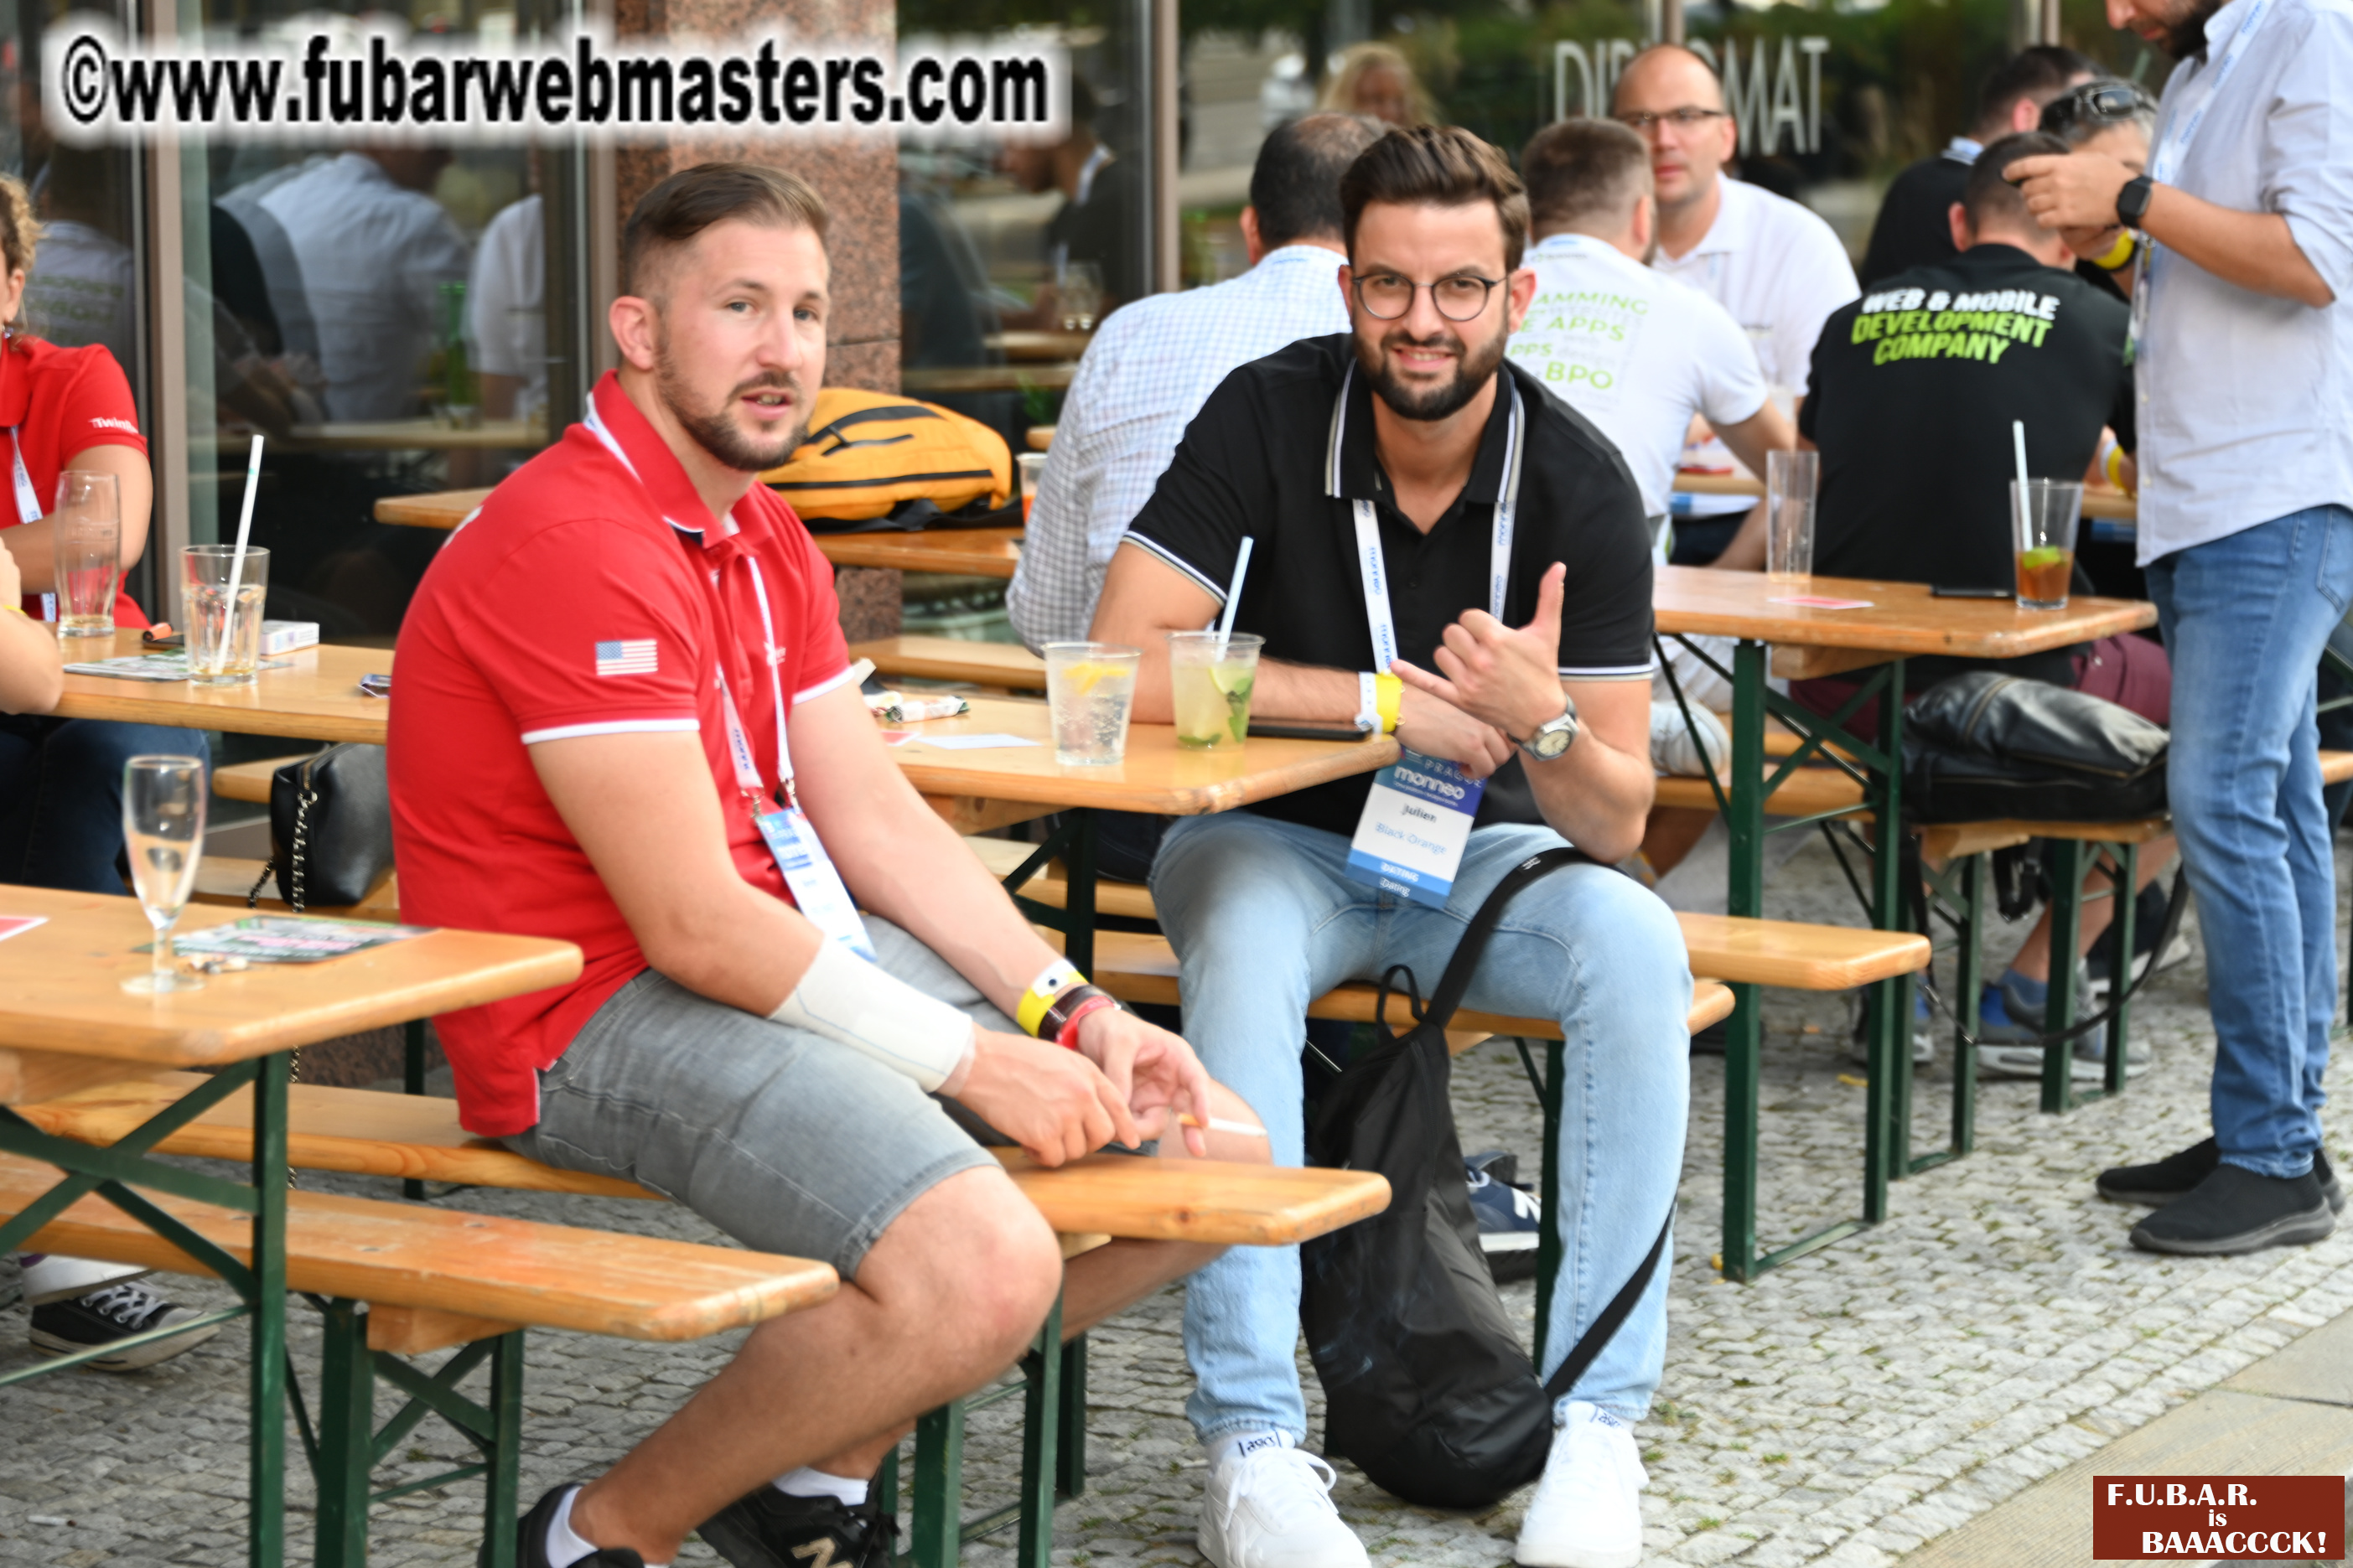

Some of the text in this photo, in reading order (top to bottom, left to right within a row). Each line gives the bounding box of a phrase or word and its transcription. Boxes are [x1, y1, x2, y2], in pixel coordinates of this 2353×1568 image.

[1554, 36, 1830, 157] DIMAT
[1862, 287, 2060, 320] WEB & MOBILE
[1546, 316, 1626, 341] APPS
[1851, 309, 2053, 348] DEVELOPMENT
[1509, 342, 1553, 357] PPS
[1873, 331, 2011, 365] COMPANY
[1545, 361, 1614, 390] BPO
[1394, 765, 1465, 800] monneo
